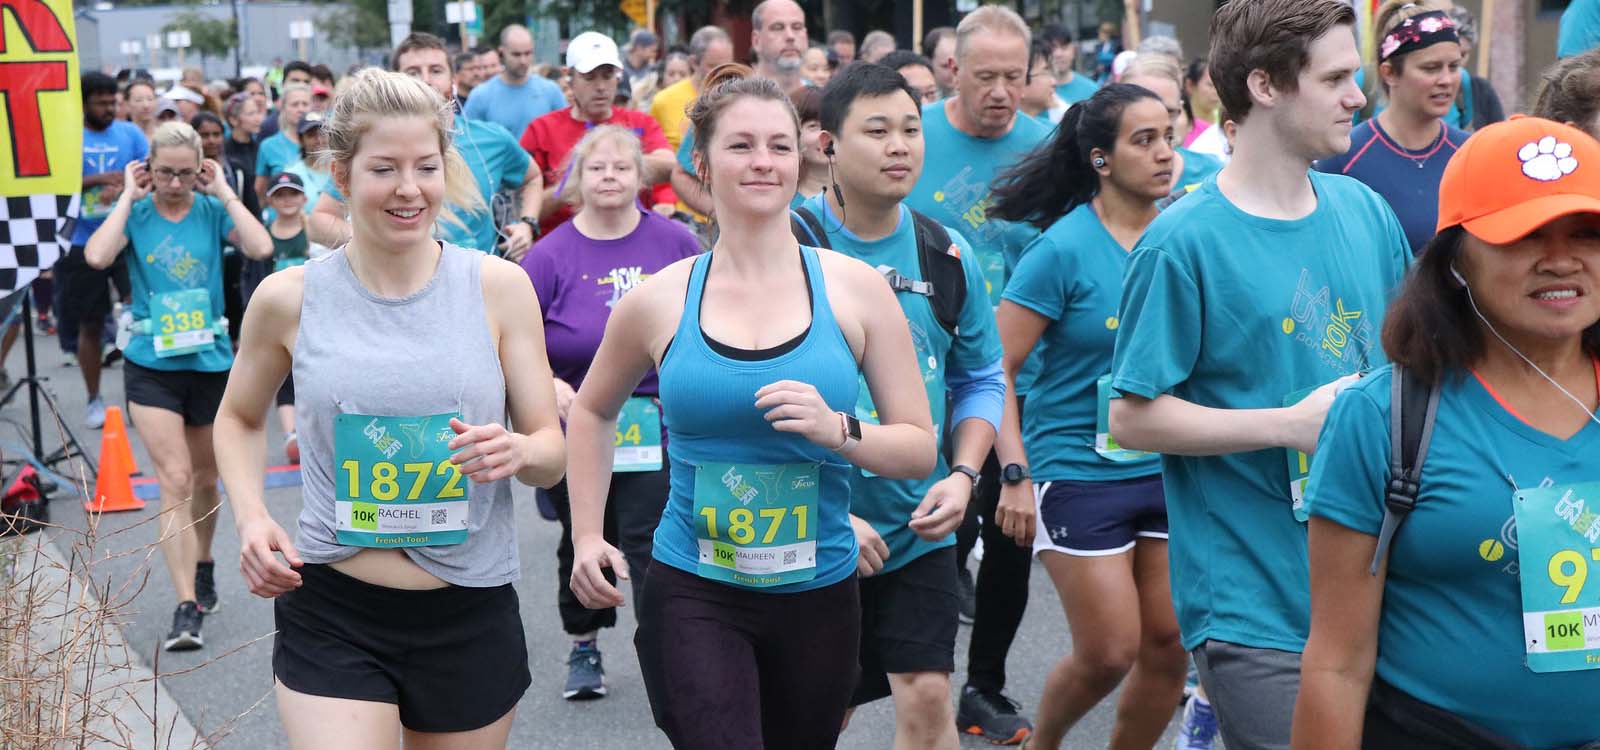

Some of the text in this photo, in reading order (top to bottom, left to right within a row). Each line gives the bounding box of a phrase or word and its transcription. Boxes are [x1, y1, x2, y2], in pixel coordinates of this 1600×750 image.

[160, 309, 205, 334] 338
[1322, 297, 1362, 358] 10K
[342, 460, 465, 501] 1872
[353, 508, 421, 522] 10K RACHEL
[700, 505, 808, 545] 1871
[375, 536, 404, 544] French
[714, 548, 775, 562] 10K MAUREEN
[1548, 622, 1581, 638] 10K
